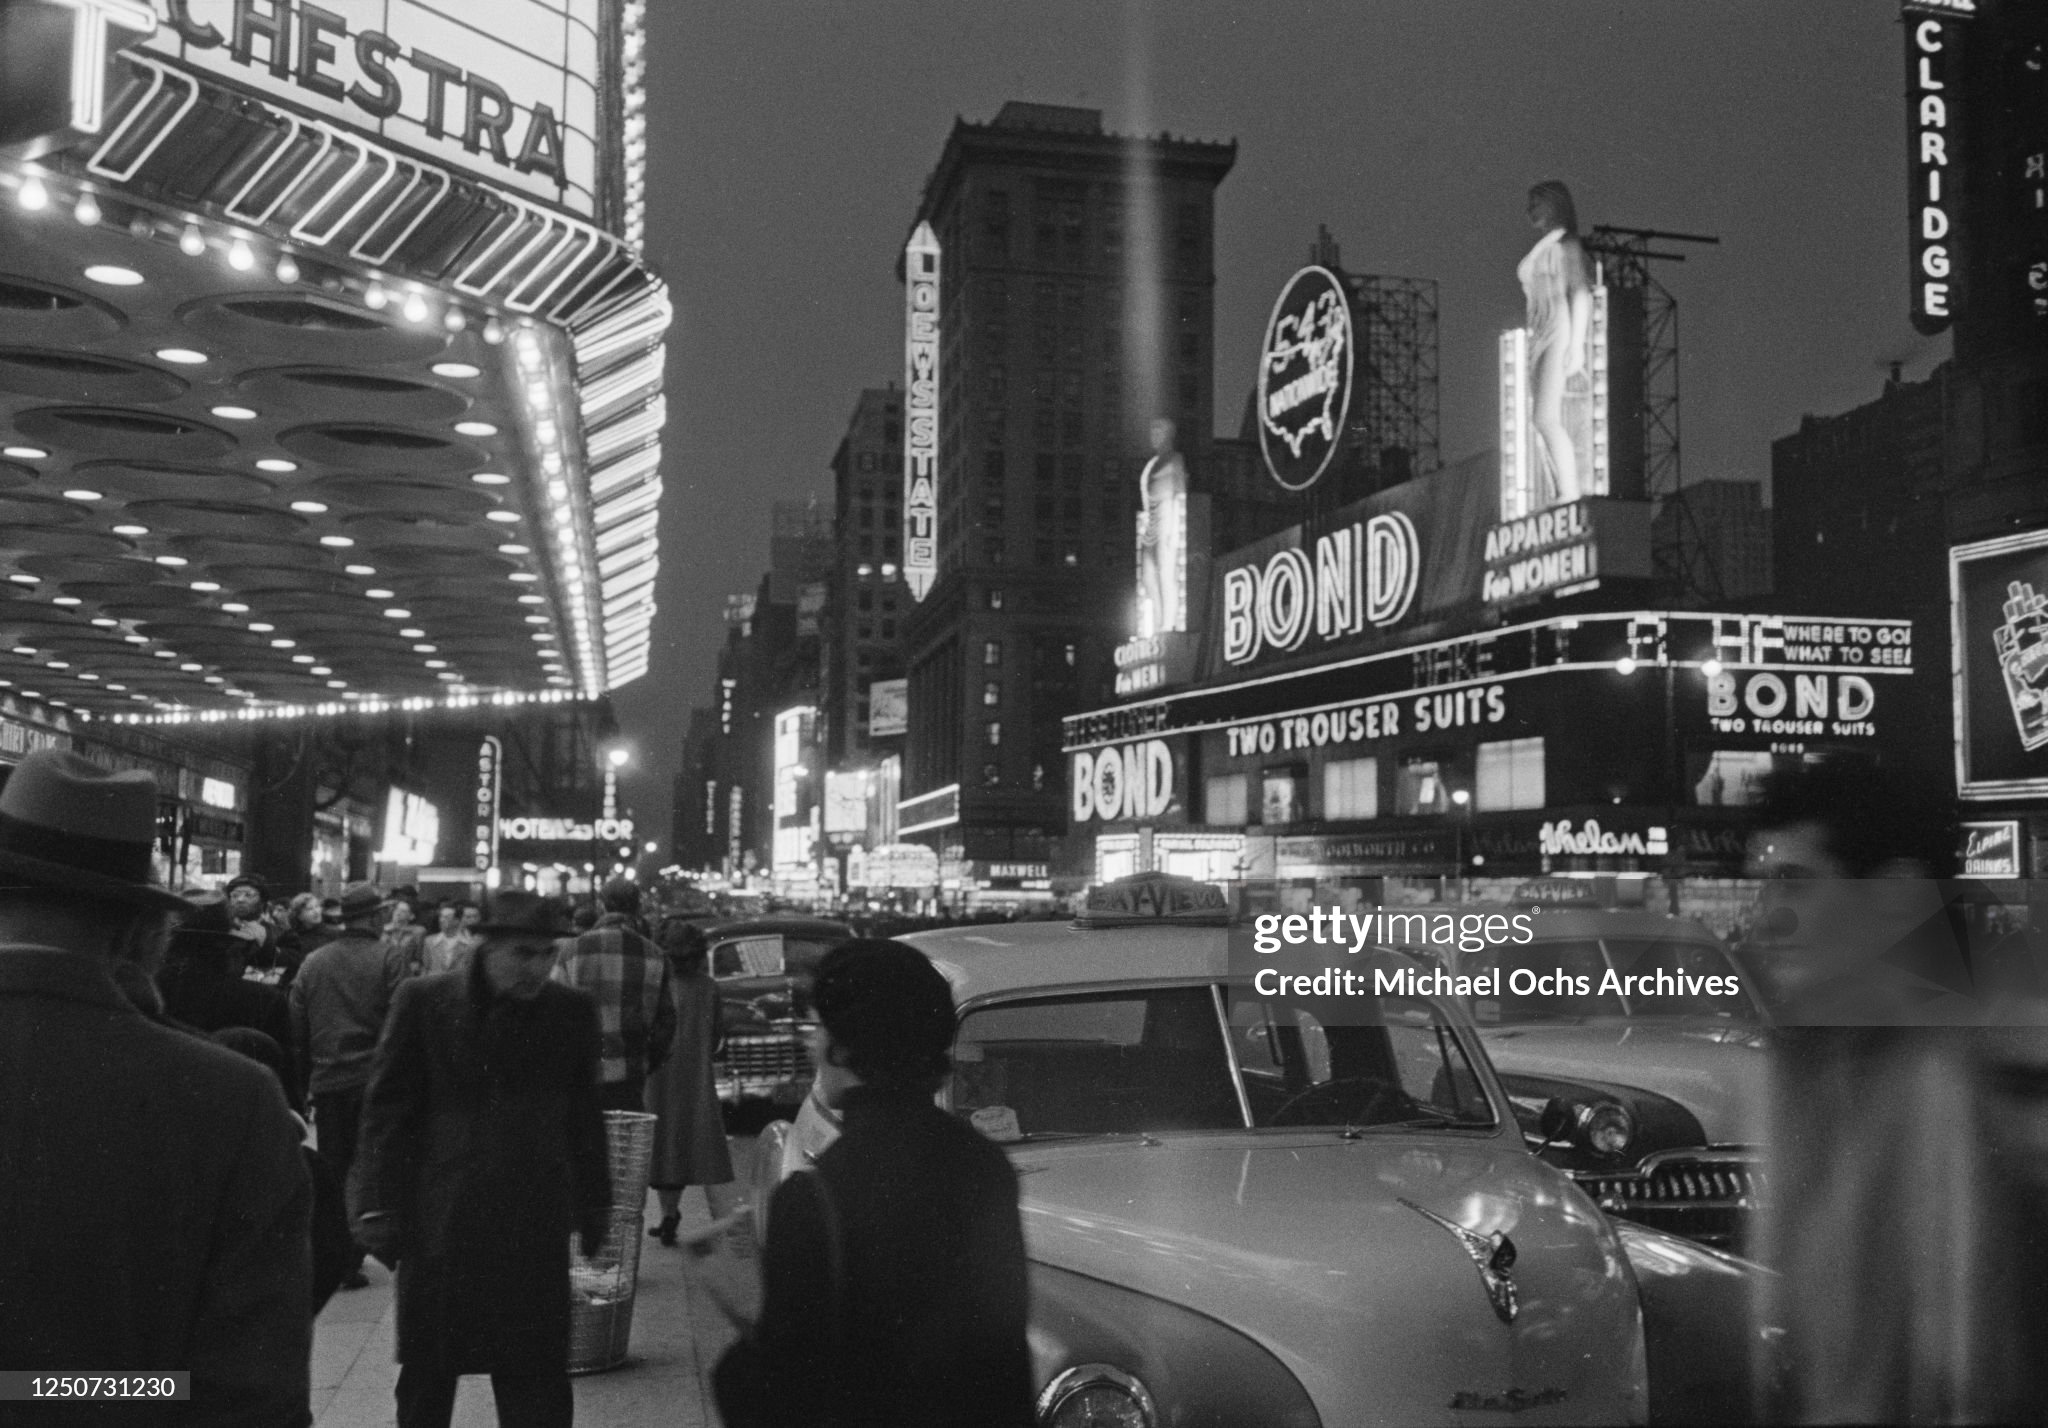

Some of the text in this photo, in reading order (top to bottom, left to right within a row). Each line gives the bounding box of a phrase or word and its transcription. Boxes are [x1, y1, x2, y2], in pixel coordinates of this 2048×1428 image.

[1916, 20, 1950, 316] CLARIDGE
[910, 418, 938, 568] STATE
[1484, 503, 1584, 561] APPAREL
[1224, 511, 1420, 664] BOND
[1510, 544, 1587, 594] WOMEN
[1783, 625, 1844, 643] WHERE
[1848, 626, 1872, 644] TO
[1784, 645, 1832, 663] WHAT
[1839, 646, 1864, 664] TO
[1227, 685, 1506, 757] TWO TROUSER SUITS
[1707, 672, 1875, 721] BOND
[1710, 717, 1876, 736] TWO TROUSER SUITS
[1073, 739, 1175, 822] BOND
